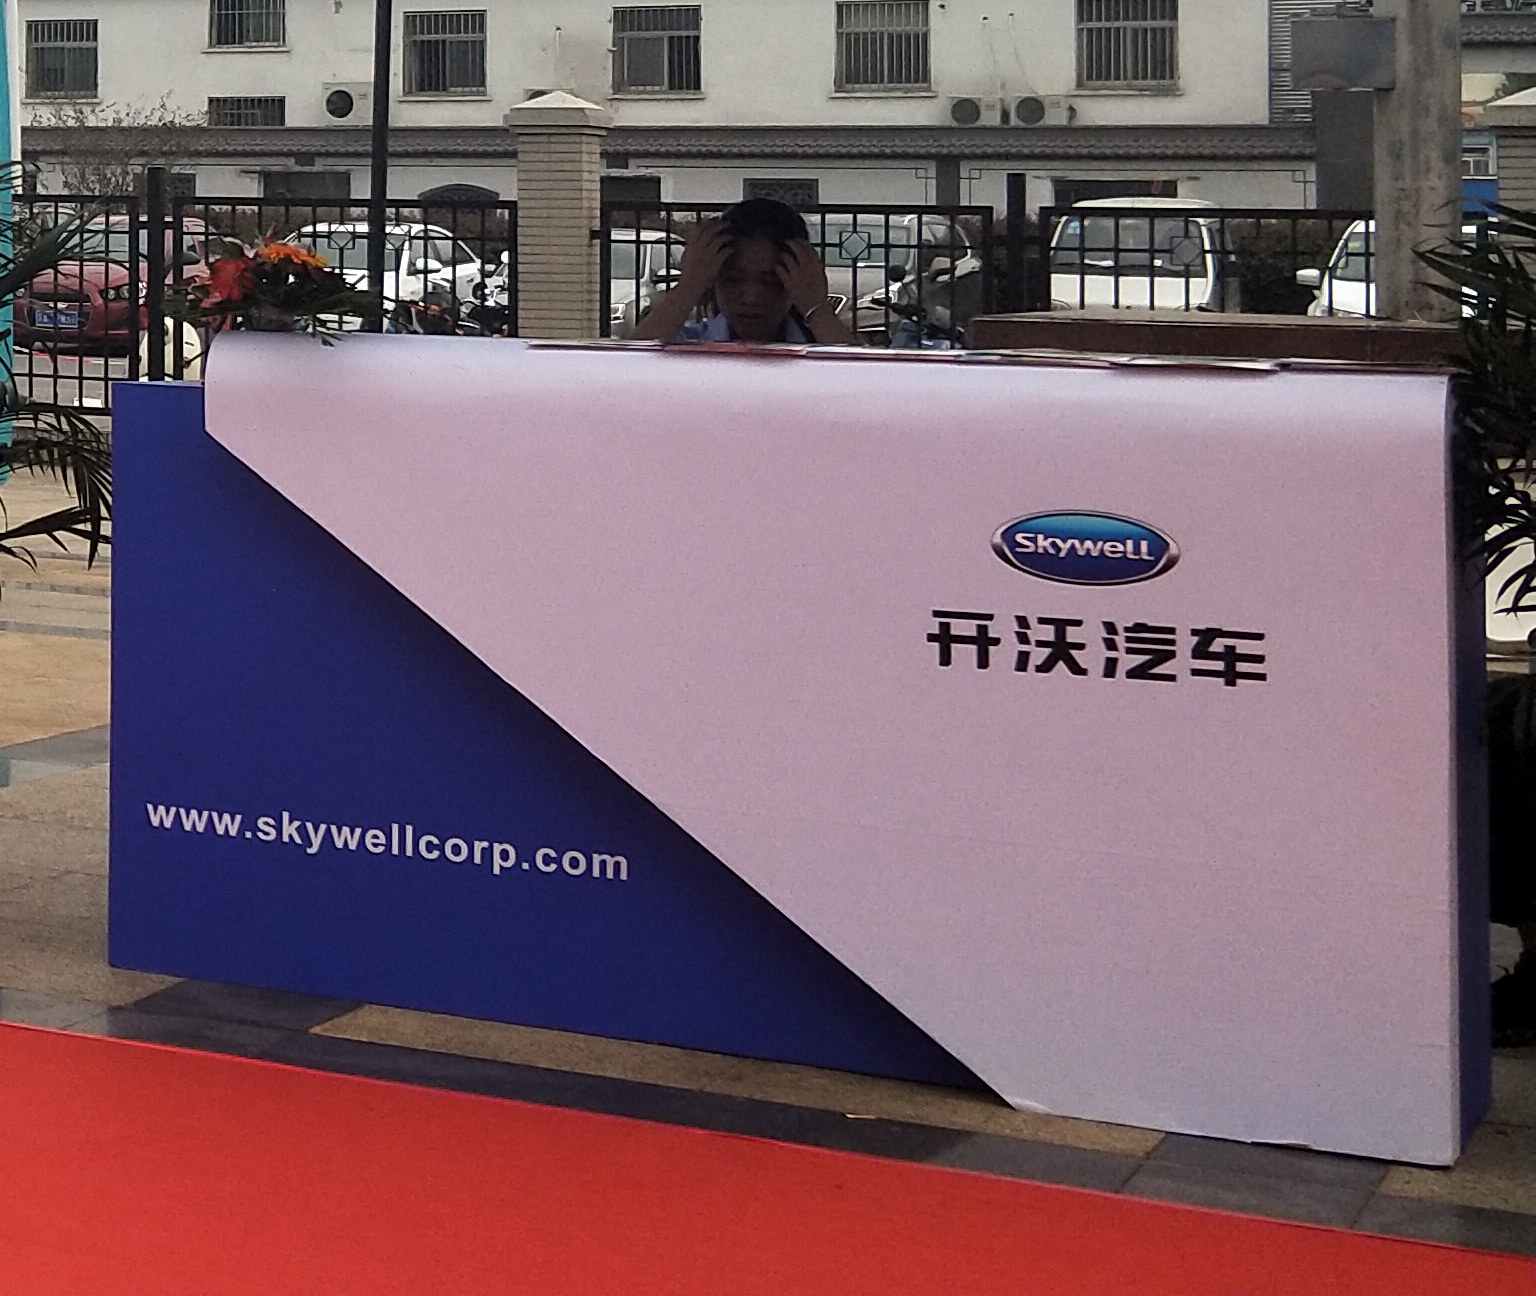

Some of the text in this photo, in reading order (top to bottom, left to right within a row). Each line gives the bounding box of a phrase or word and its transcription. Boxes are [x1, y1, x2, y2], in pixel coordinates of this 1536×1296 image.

[1014, 532, 1156, 562] Skywell
[926, 609, 1268, 688] 开沃汽车
[147, 802, 628, 881] www.skywellcorp.com
